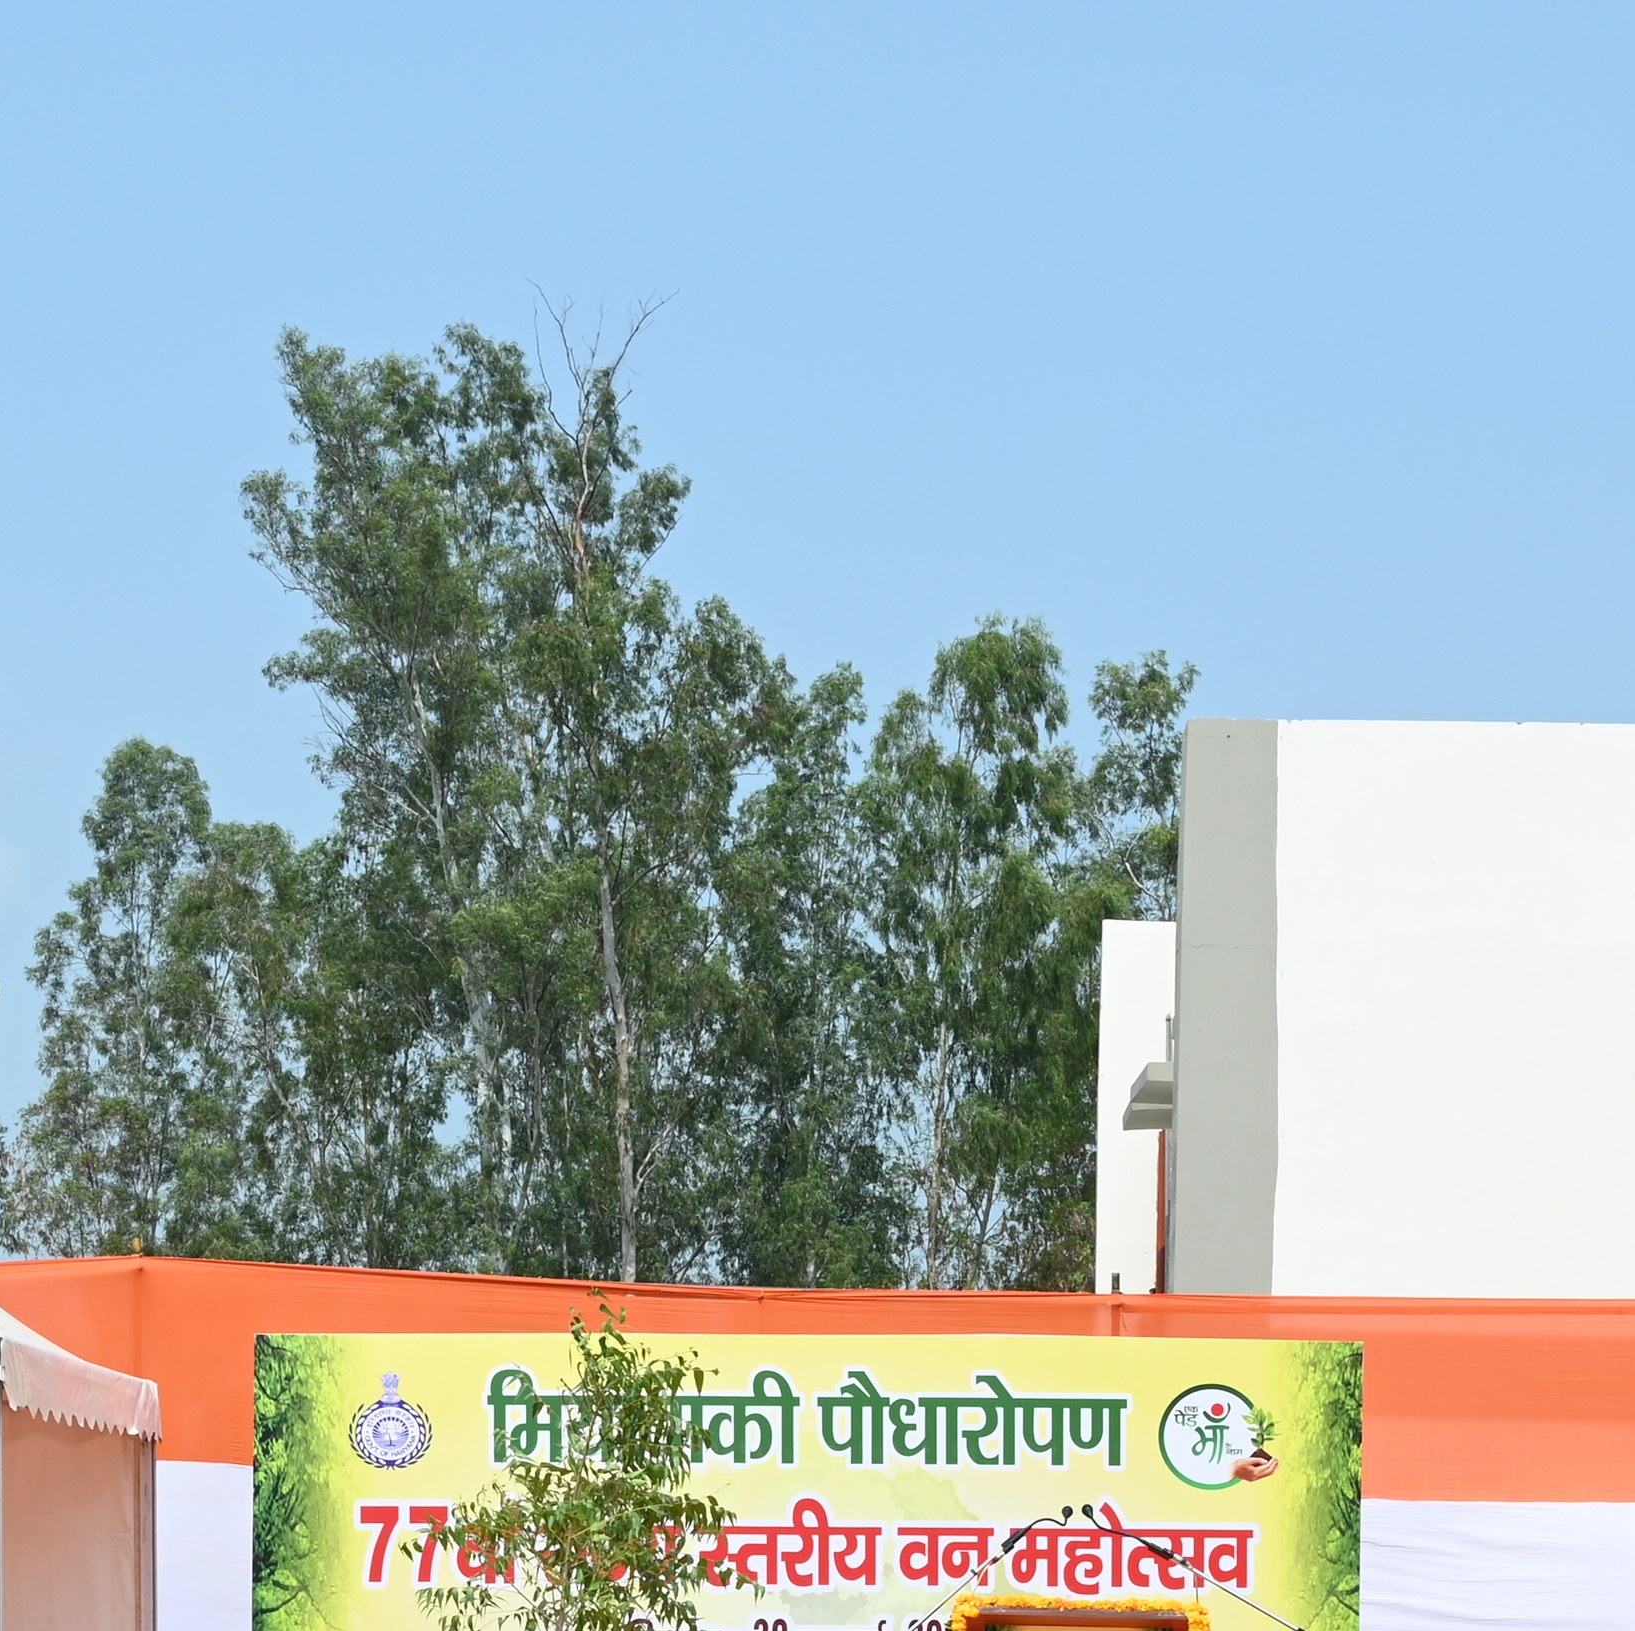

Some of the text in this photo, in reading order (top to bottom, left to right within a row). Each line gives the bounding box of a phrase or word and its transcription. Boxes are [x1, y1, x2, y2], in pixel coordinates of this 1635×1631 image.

[818, 1371, 1128, 1467] पौधारोपण
[897, 1527, 994, 1587] वन
[1011, 1502, 1254, 1596] महोत्सव
